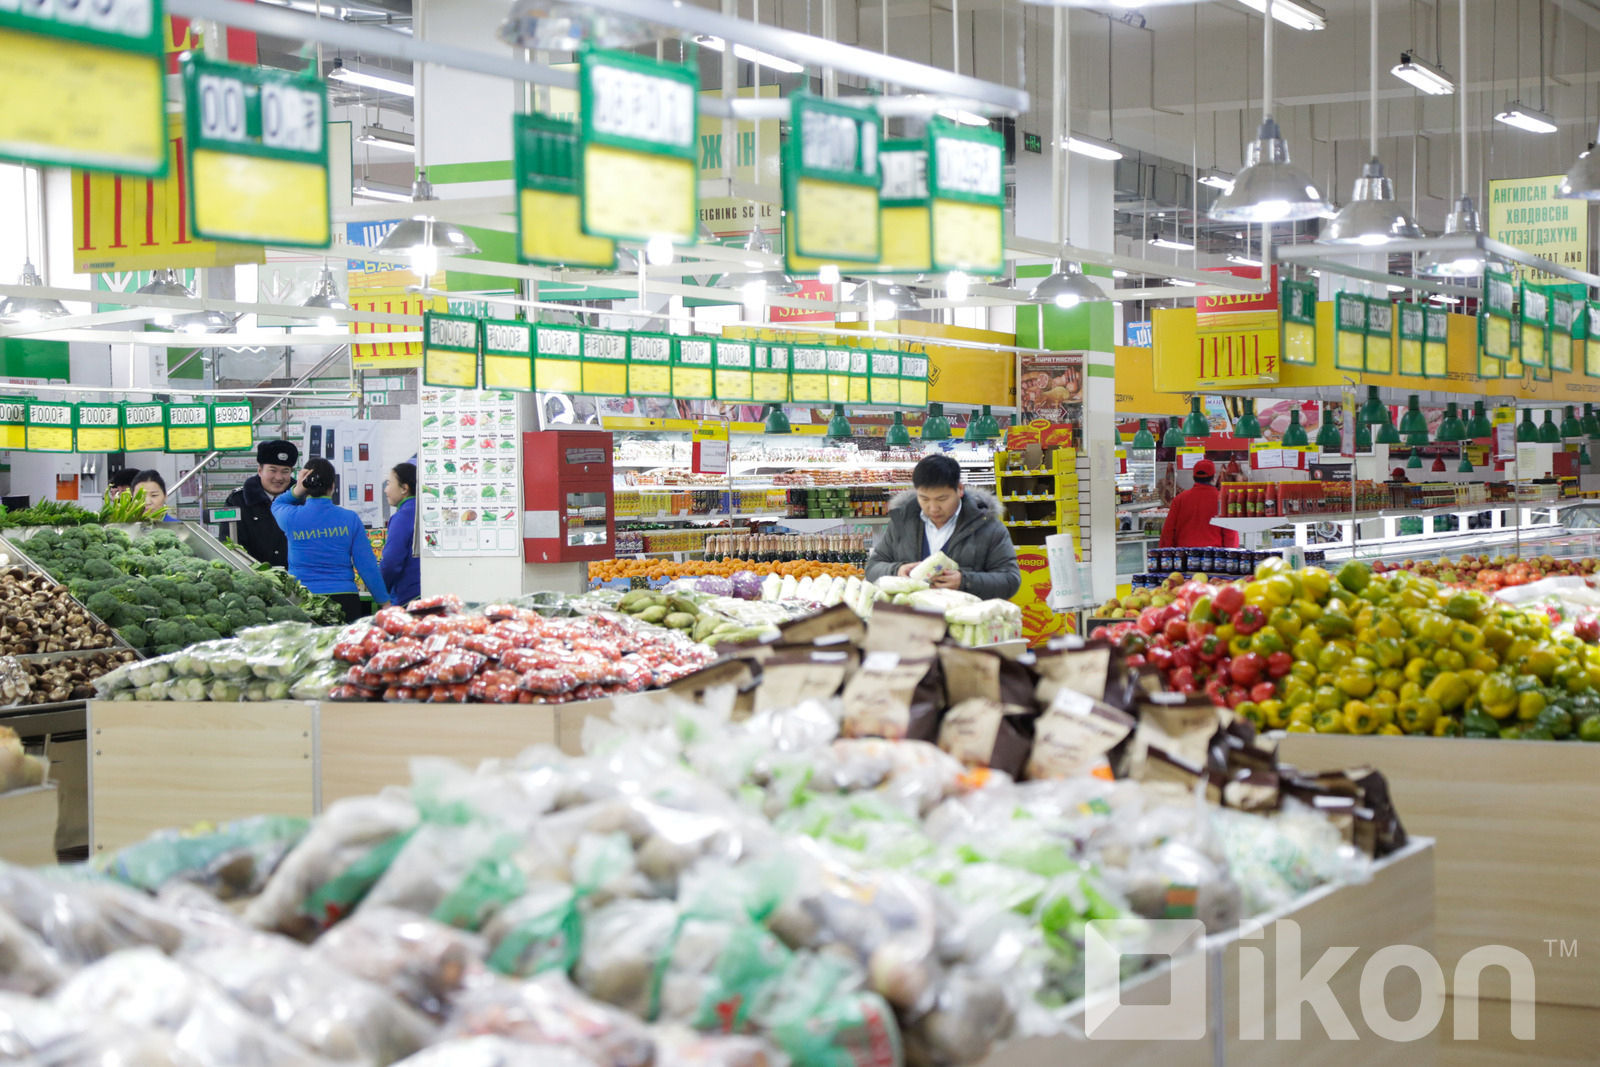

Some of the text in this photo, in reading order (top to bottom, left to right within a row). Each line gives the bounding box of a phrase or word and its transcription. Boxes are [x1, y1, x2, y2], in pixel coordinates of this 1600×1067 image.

[694, 205, 771, 222] EIGHING SCLE
[1564, 251, 1582, 263] AND
